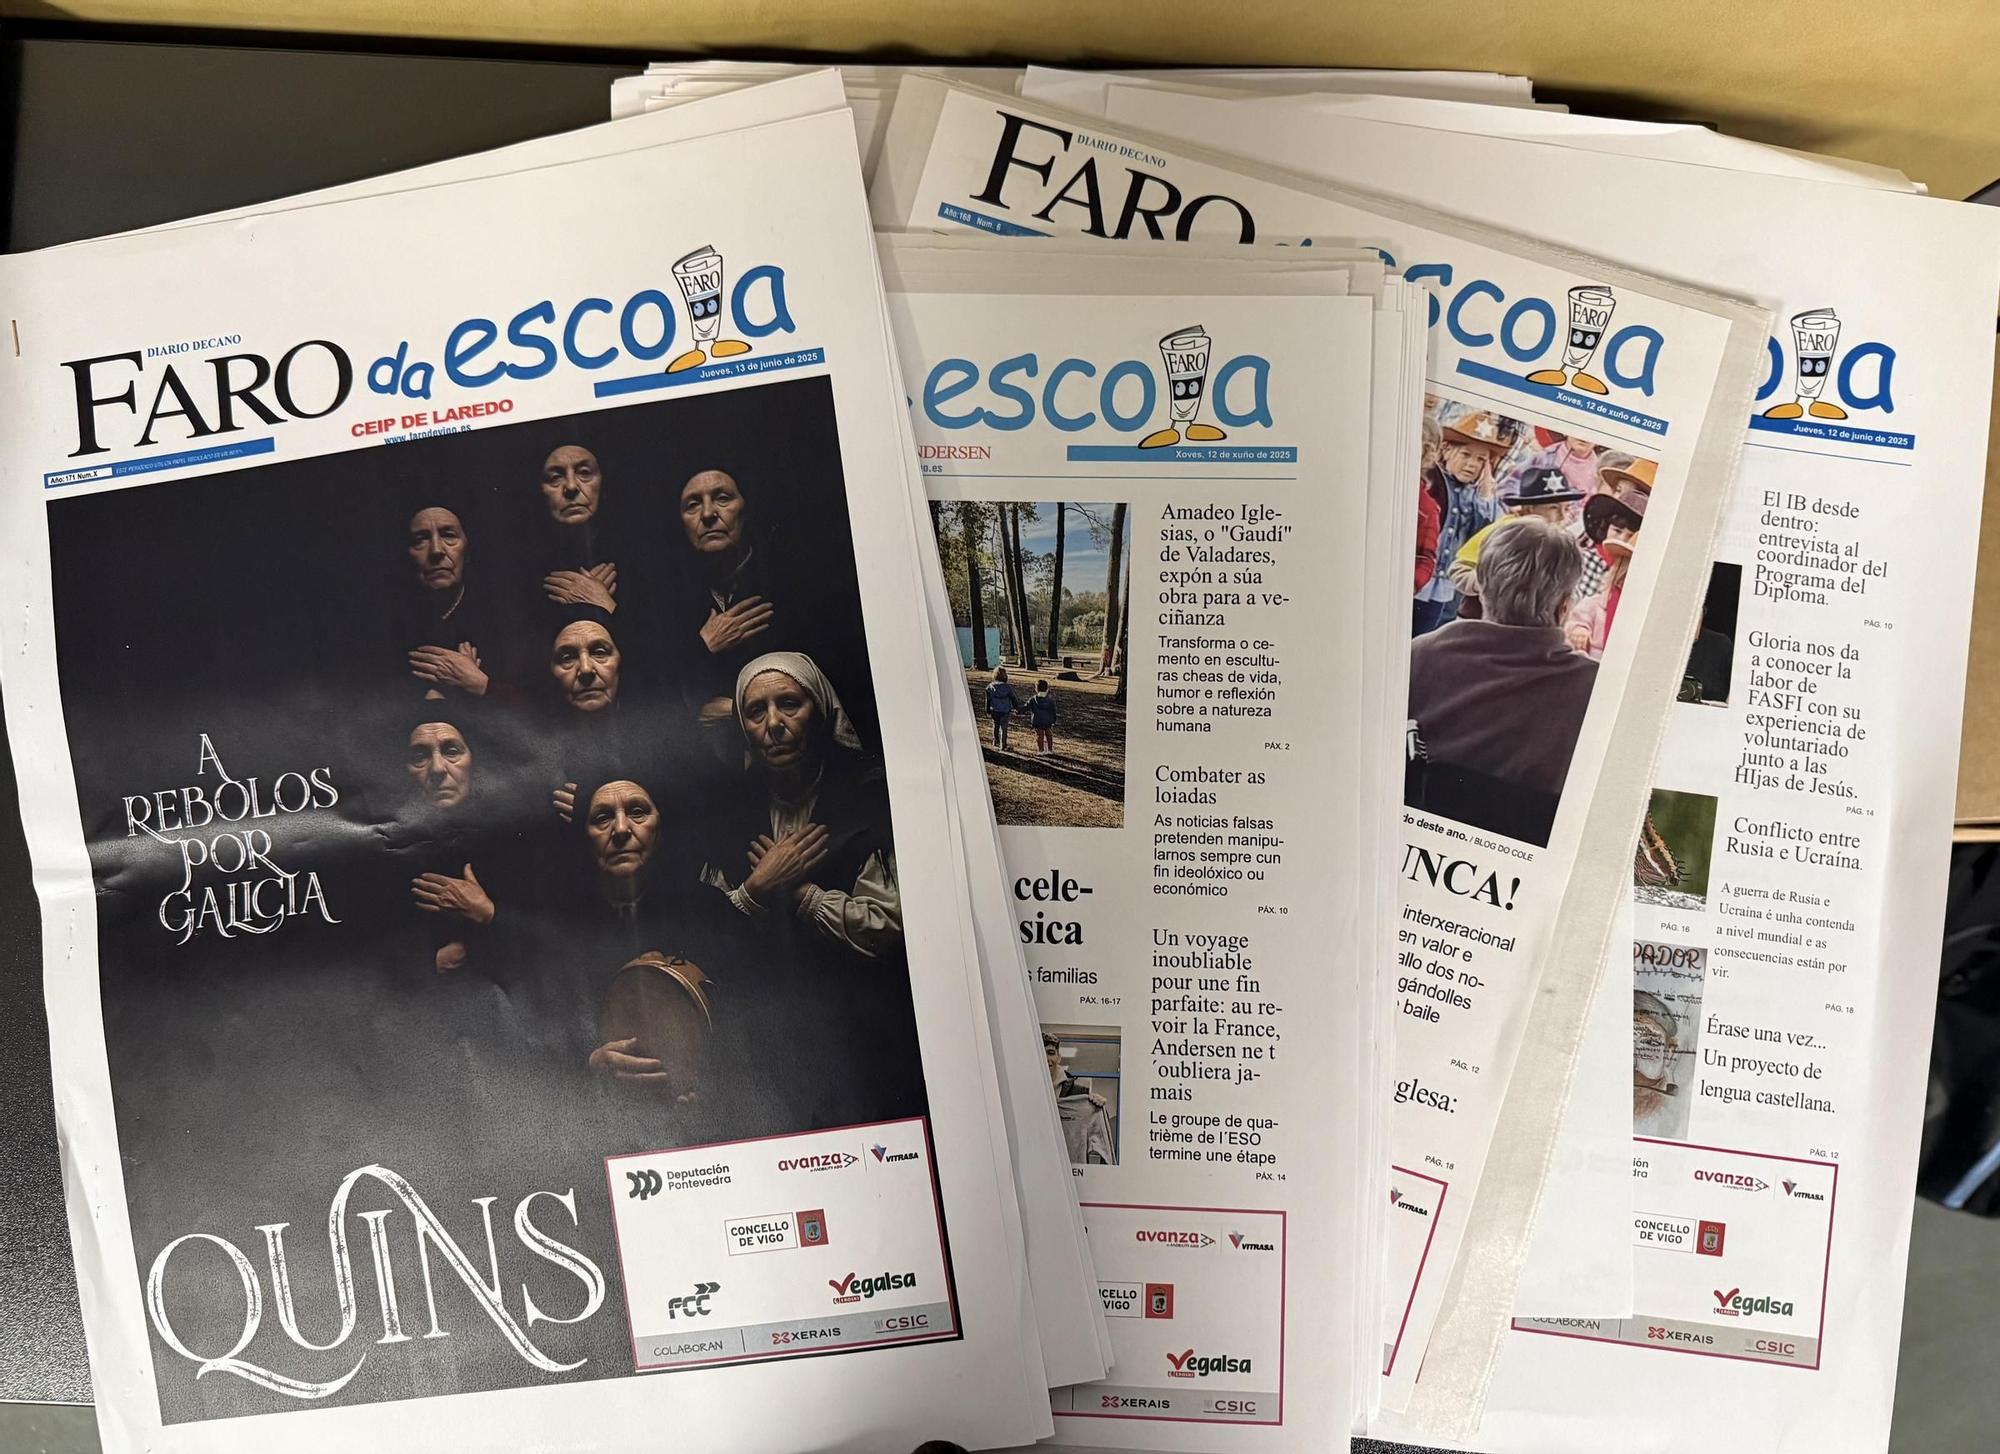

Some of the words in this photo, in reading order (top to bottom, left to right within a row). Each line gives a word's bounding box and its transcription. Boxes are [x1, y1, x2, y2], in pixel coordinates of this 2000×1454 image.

[1077, 134, 1118, 153] DIARIO
[1119, 146, 1166, 168] DECANO
[969, 110, 1256, 245] FARO
[680, 271, 720, 297] FARO
[1572, 302, 1608, 328] FARO
[146, 342, 190, 358] DIARIO
[192, 333, 242, 351] DECANO
[1797, 330, 1835, 352] FARO
[700, 367, 733, 379] Jueves,
[736, 365, 746, 373] 13
[747, 363, 758, 371] de
[760, 358, 782, 372] junio
[784, 356, 795, 364] de
[798, 353, 818, 362] 2025
[1166, 352, 1206, 374] FARO
[60, 338, 354, 458] FARO
[367, 340, 434, 400] da
[351, 418, 396, 437] CEIP
[401, 412, 427, 429] DE
[433, 399, 514, 424] LAREDO
[1793, 424, 1825, 435] Jueves,
[1828, 429, 1837, 437] 12
[1839, 429, 1849, 439] de
[1851, 431, 1873, 442] junio
[1875, 433, 1886, 443] de
[1887, 436, 1908, 445] 2025
[1176, 450, 1205, 459] Xoves,
[1232, 450, 1255, 459] xuño
[1257, 451, 1267, 459] de
[1270, 451, 1291, 459] 2025
[50, 474, 65, 485] Año:
[65, 472, 76, 482] 171
[1161, 503, 1235, 520] Amadeo
[1241, 504, 1282, 525] Igle-
[1763, 490, 1780, 508] El
[1787, 494, 1807, 511] IB
[1812, 498, 1860, 519] desde
[1761, 510, 1819, 532] dentro:
[1160, 524, 1198, 544] sias,
[1204, 530, 1215, 541] o
[1221, 525, 1292, 542] "Gaudí"
[1759, 533, 1839, 555] entrevista
[1844, 542, 1859, 557] al
[1160, 545, 1180, 562] de
[1186, 546, 1276, 566] Valadares,
[1757, 549, 1858, 574] coordinador
[1862, 560, 1888, 578] del
[1756, 564, 1835, 590] Programa
[1841, 576, 1866, 594] del
[1754, 580, 1829, 605] Diploma.
[1864, 619, 1882, 629] PÁG.
[1158, 635, 1236, 649] Transforma
[1240, 640, 1249, 649] o
[1253, 639, 1275, 649] ce-
[1749, 630, 1801, 652] Gloria
[1807, 642, 1835, 658] nos
[1841, 644, 1859, 661] da
[1746, 713, 1841, 738] experiencia
[1847, 723, 1866, 740] de
[1265, 742, 1283, 750] PÁX.
[1744, 730, 1849, 758] voluntariado
[197, 733, 240, 783] A
[1155, 765, 1242, 784] Combater
[1247, 772, 1265, 784] as
[122, 766, 339, 845] REBOLOS
[1155, 787, 1217, 804] loiadas
[1417, 817, 1445, 834] deste
[1446, 829, 1468, 841] ano.
[1474, 837, 1496, 850] BLOG
[1498, 844, 1510, 853] DO
[1511, 849, 1534, 861] COLE
[1734, 816, 1814, 843] Conflicto
[1819, 832, 1861, 849] entre
[175, 829, 300, 895] POR
[1014, 869, 1093, 902] cele-
[159, 871, 343, 946] GALICIA
[1019, 911, 1083, 945] sica
[1403, 904, 1516, 952] interxeracional
[1682, 925, 1690, 933] 16
[1153, 929, 1179, 946] Un
[1185, 934, 1249, 952] voyage
[1422, 937, 1460, 958] valor
[1462, 950, 1472, 962] e
[1152, 950, 1252, 970] inoubliable
[1037, 966, 1098, 984] familias
[1080, 996, 1098, 1004] PÁX.
[1101, 997, 1121, 1005] 16-17
[1398, 977, 1472, 1010] gándolles
[1403, 999, 1440, 1023] baile
[1152, 1017, 1187, 1034] voir
[1193, 1017, 1209, 1035] la
[1215, 1018, 1281, 1040] France,
[1707, 1013, 1750, 1039] Érase
[1754, 1027, 1782, 1043] una
[1787, 1032, 1827, 1049] vez...
[1450, 1059, 1468, 1071] PÁG.
[1472, 1066, 1480, 1074] 12
[1704, 1048, 1727, 1067] Un
[1731, 1057, 1799, 1076] proyecto
[1803, 1062, 1822, 1080] de
[1700, 1080, 1751, 1104] lengua
[1756, 1090, 1836, 1113] castellana.
[778, 1152, 842, 1172] avanza
[886, 1151, 919, 1163] VITRASA
[1810, 1149, 1828, 1158] PÁG.
[1830, 1151, 1839, 1159] 12
[666, 1163, 730, 1181] Deputación
[668, 1174, 732, 1191] Pontevedra
[1694, 1169, 1754, 1187] avanza
[1793, 1191, 1825, 1201] VITRASA
[1398, 1201, 1428, 1216] VITRASA
[730, 1221, 790, 1237] CONCELLO
[1136, 1230, 1199, 1243] avanza
[1634, 1219, 1690, 1235] CONCELLO
[1640, 1231, 1653, 1241] DE
[1657, 1233, 1683, 1244] VIGO
[739, 1235, 754, 1247] DE
[756, 1232, 784, 1245] VIGO
[1242, 1243, 1274, 1251] VITRASA
[146, 1162, 607, 1400] QUINS
[829, 1271, 916, 1298] Vegalsa
[1099, 1289, 1137, 1299] CELLO
[1104, 1300, 1130, 1310] VIGO
[1713, 1288, 1794, 1317] Vegalsa
[667, 1293, 713, 1320] FCC
[885, 1314, 929, 1329] CSIC
[790, 1327, 842, 1341] XERAIS
[1665, 1330, 1714, 1345] XERAIS
[653, 1340, 723, 1357] COLABORAN
[1755, 1339, 1795, 1355] CSIC
[1166, 1349, 1251, 1377] Vegalsa
[1121, 1398, 1170, 1409] XERAIS
[1215, 1400, 1257, 1412] CSIC
